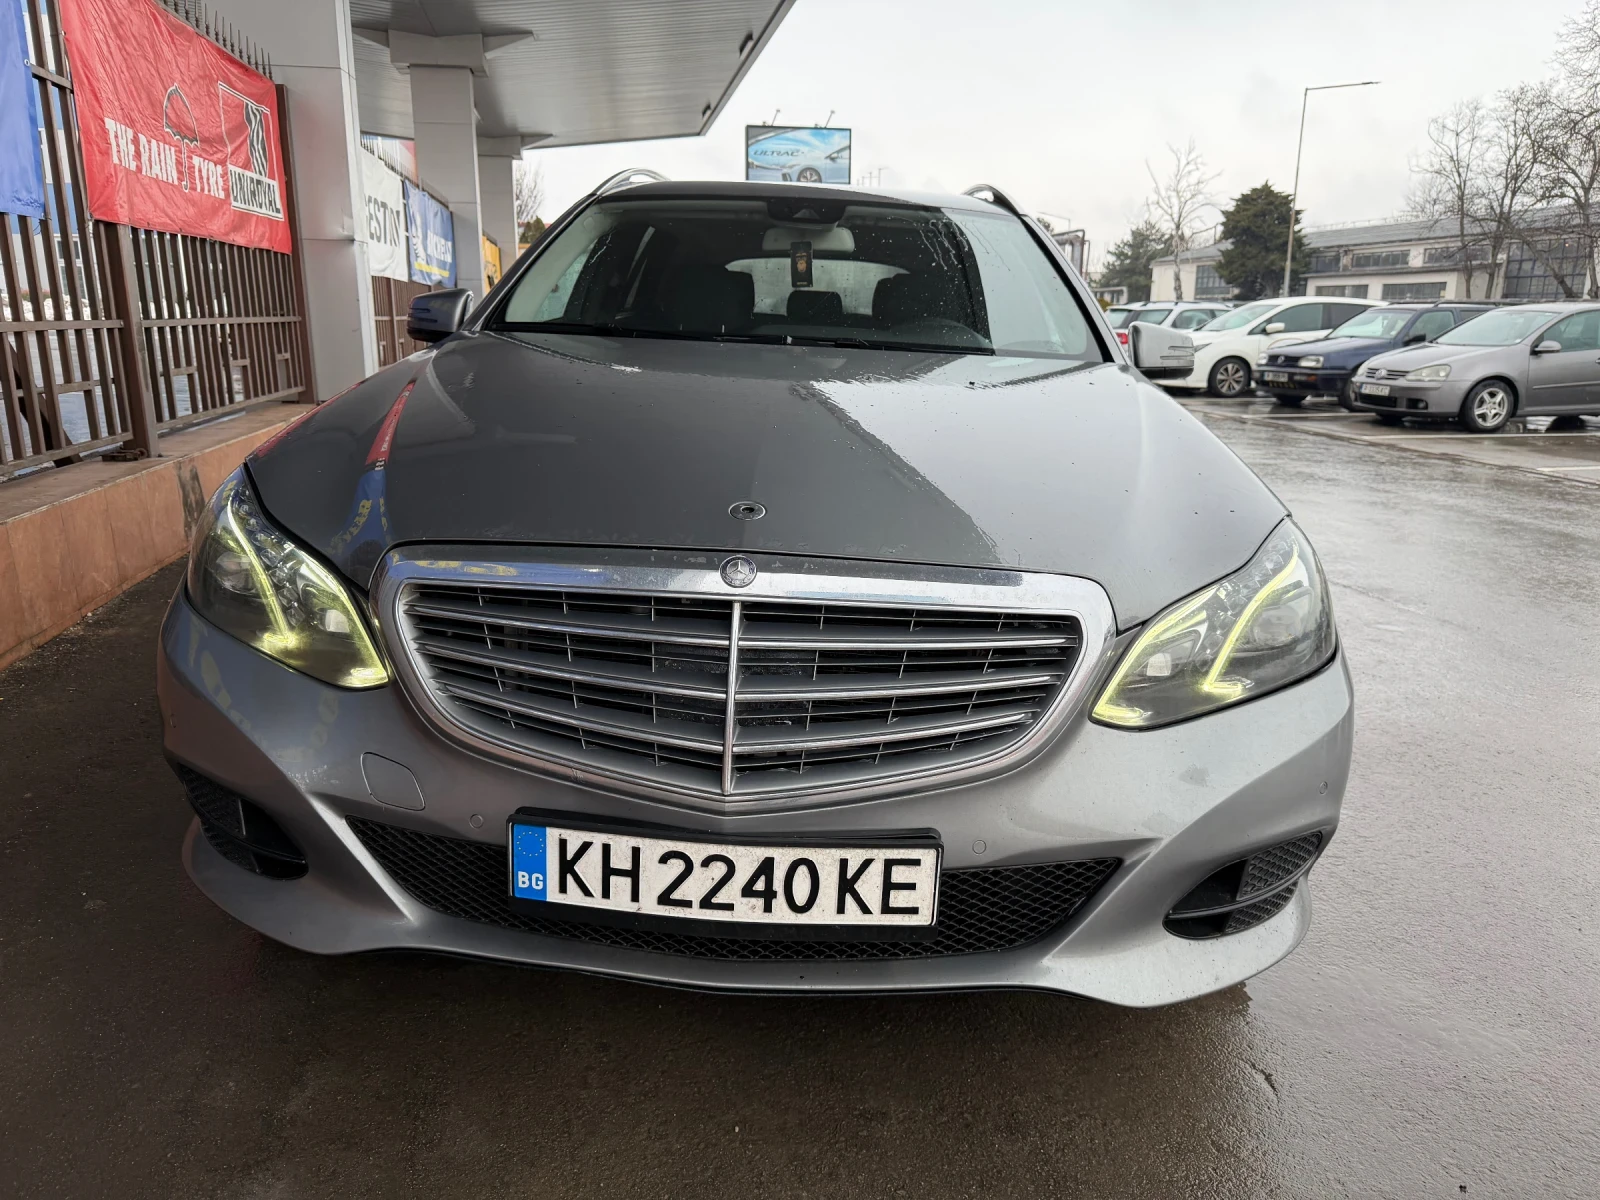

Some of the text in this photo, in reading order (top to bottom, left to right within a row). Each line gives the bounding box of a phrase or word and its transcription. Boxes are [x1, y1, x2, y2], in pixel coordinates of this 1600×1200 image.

[104, 117, 226, 199] THE RAIN TYRE
[753, 148, 799, 157] ULTRAC
[229, 168, 281, 214] UNIROYAL
[517, 870, 544, 890] BG
[558, 837, 922, 915] KH 2240 KE
